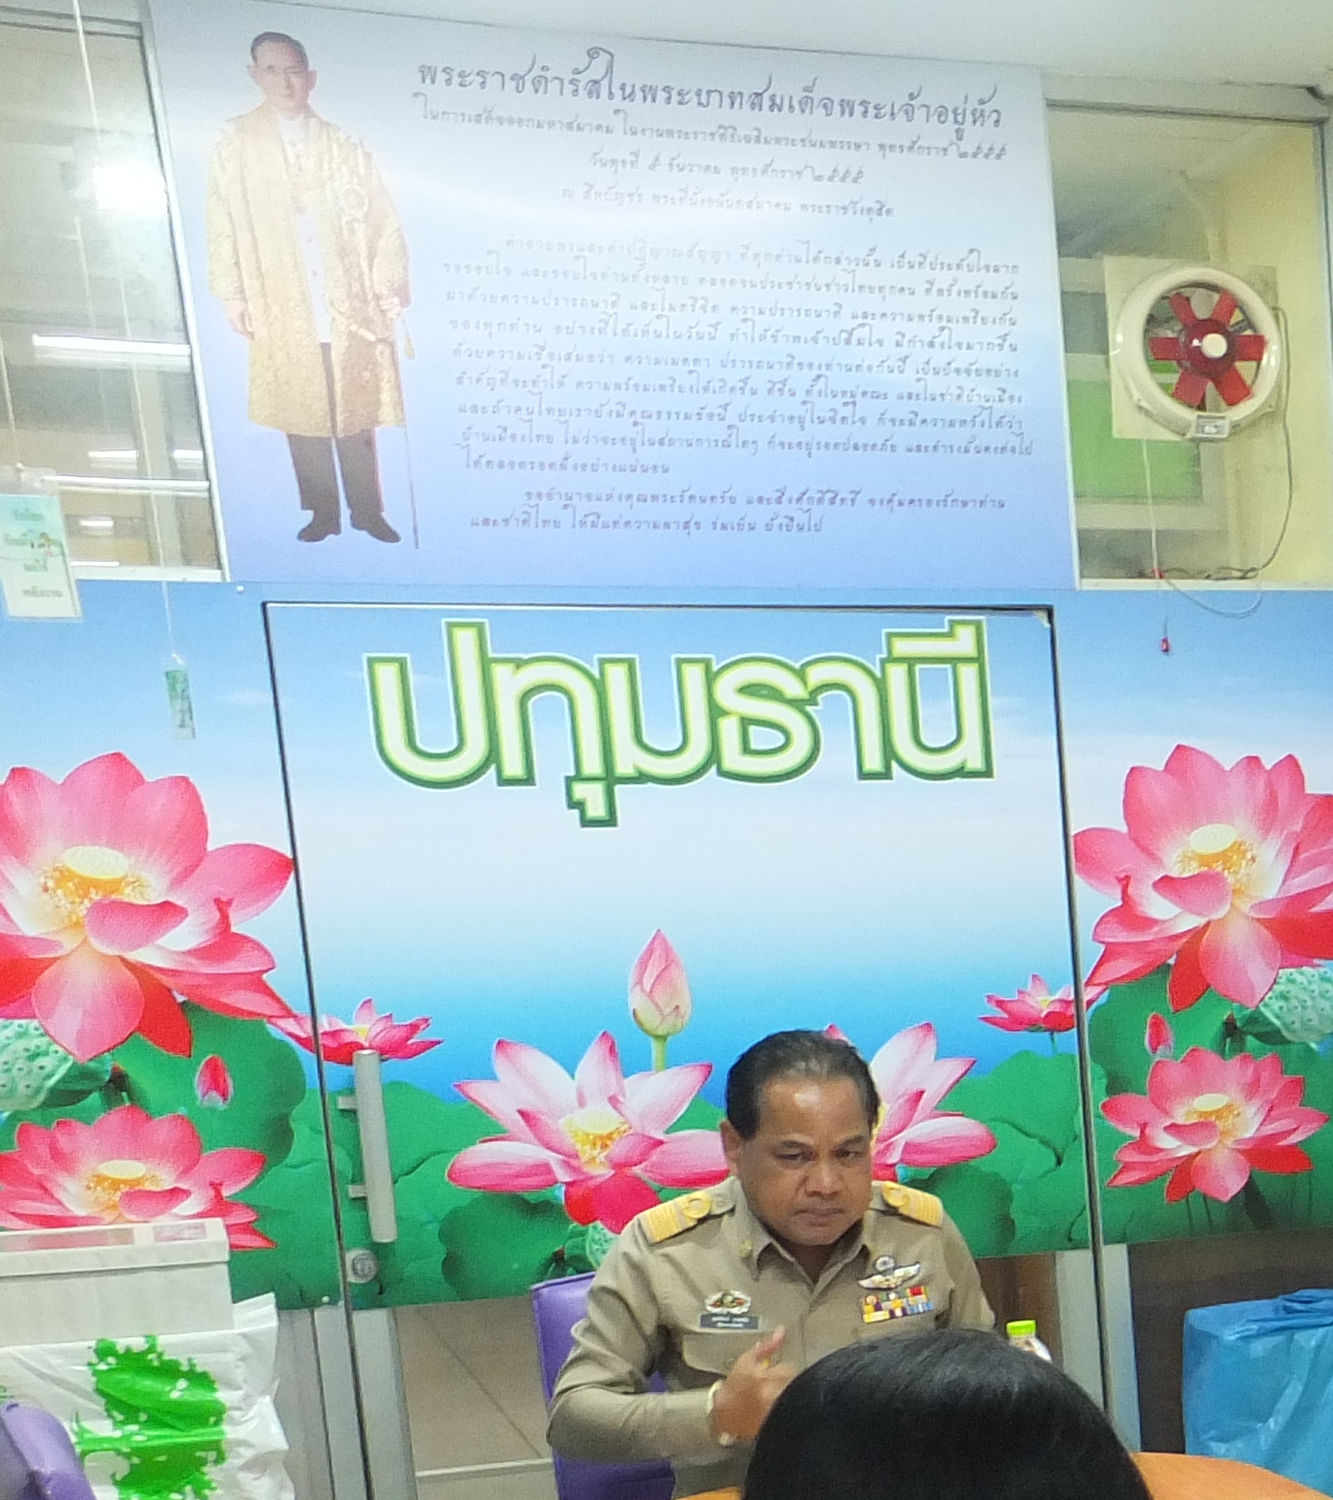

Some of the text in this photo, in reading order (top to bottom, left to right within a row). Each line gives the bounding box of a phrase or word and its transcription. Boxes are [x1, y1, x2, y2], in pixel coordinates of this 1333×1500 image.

[418, 46, 1001, 141] พระราชดำรัสในพระบาทสมเด็จพระเจ้าอยู่หัว
[363, 615, 996, 828] ปทุมธานี
